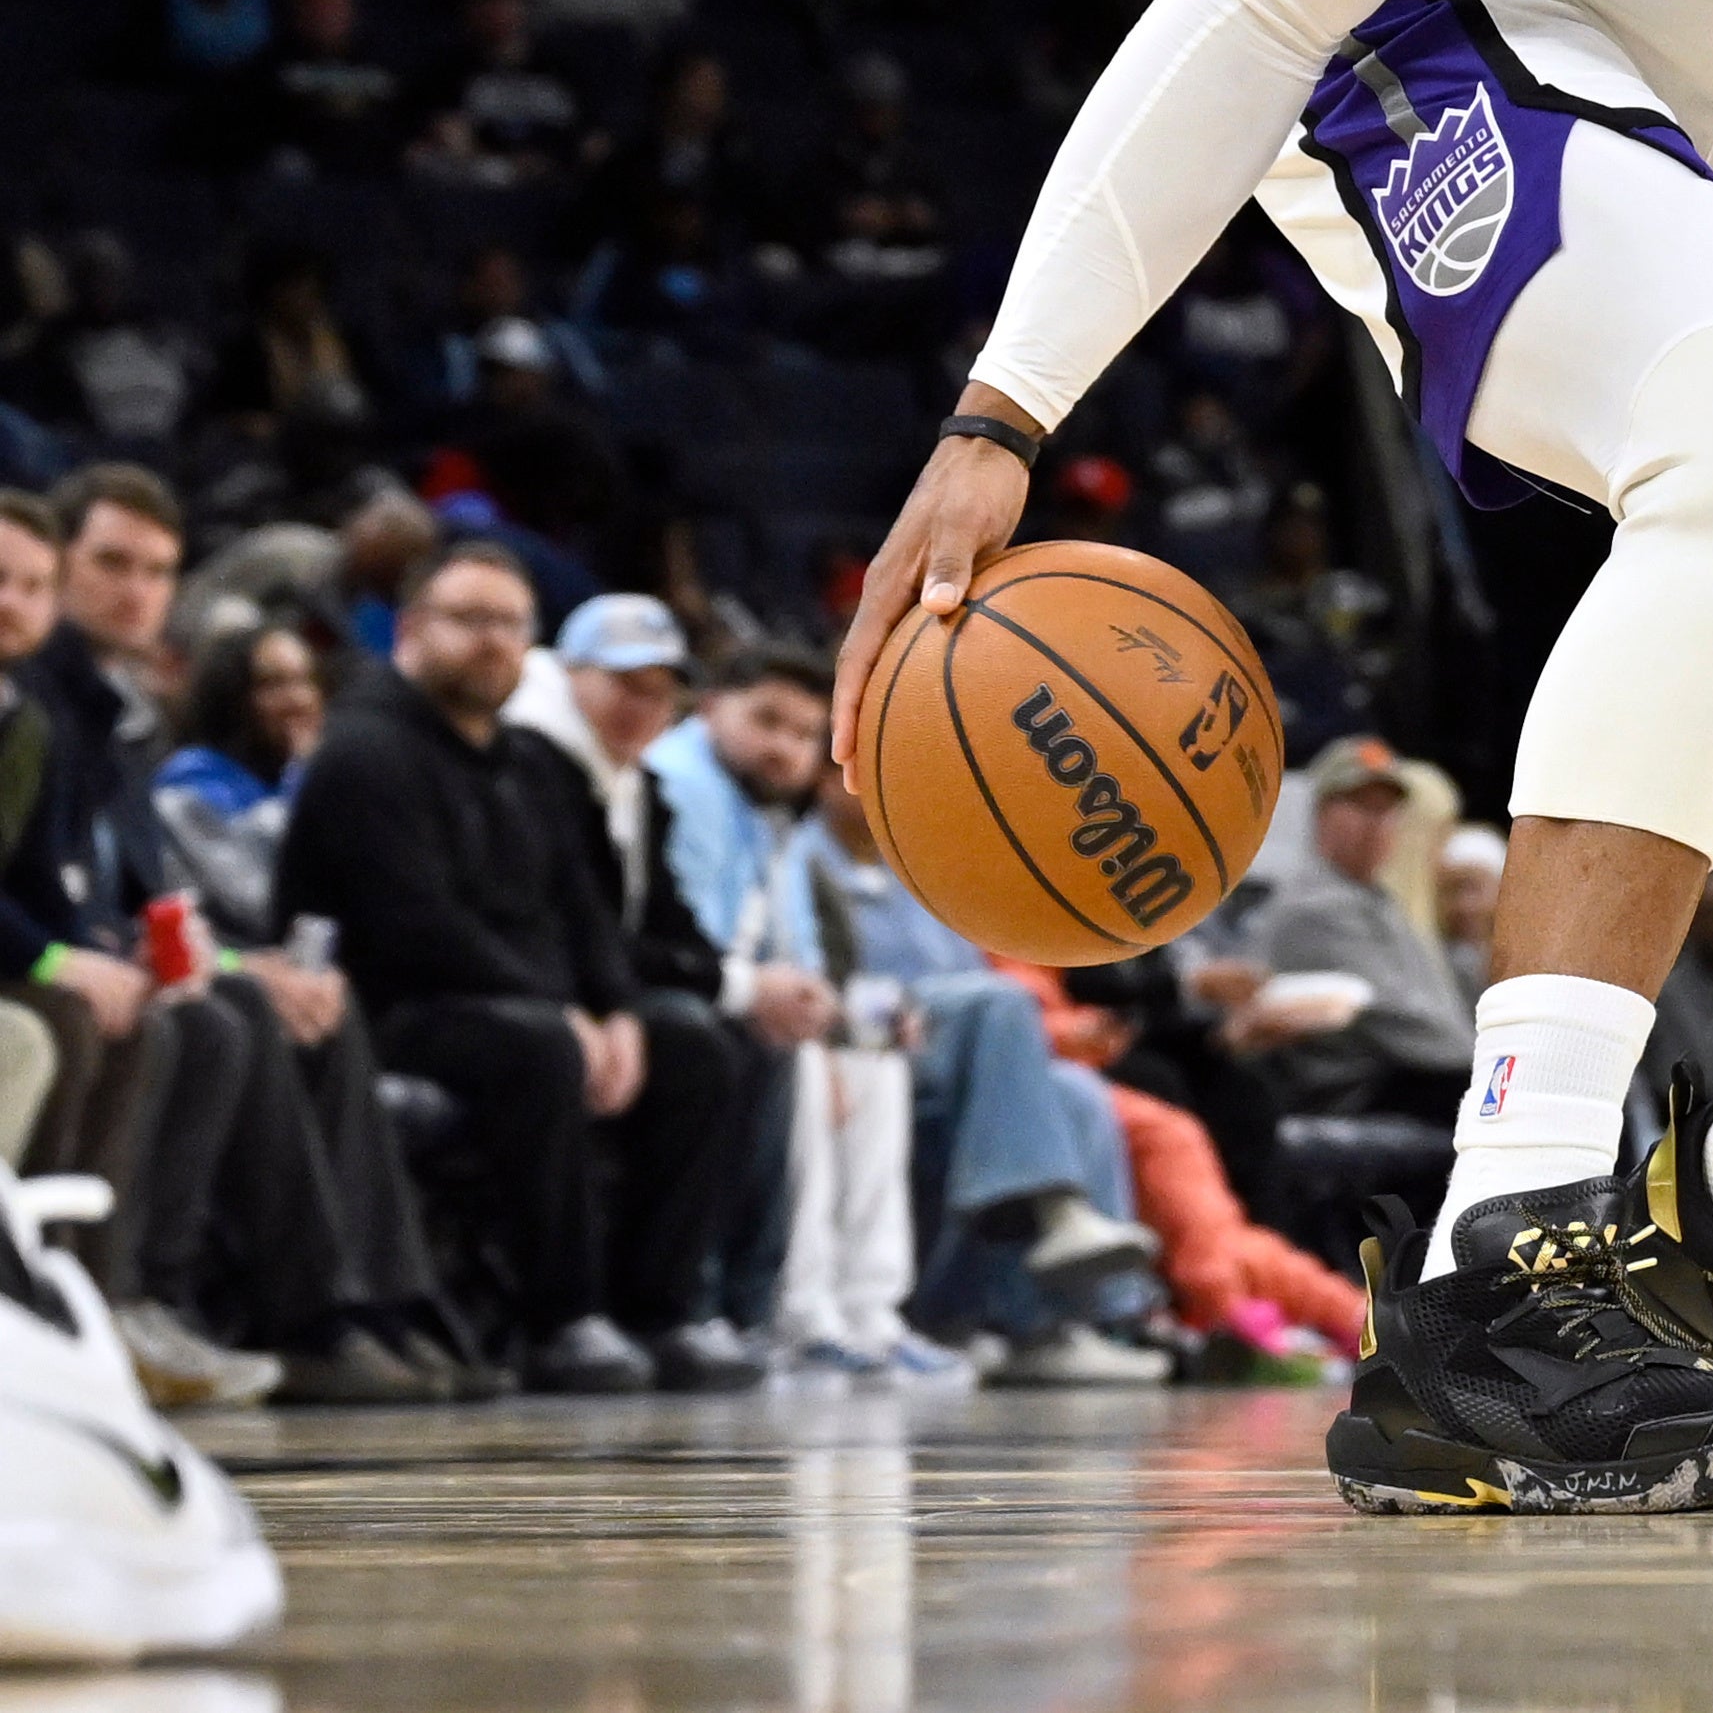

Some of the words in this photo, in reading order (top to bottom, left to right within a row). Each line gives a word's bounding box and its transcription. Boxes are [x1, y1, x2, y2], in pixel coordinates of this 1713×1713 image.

[1390, 126, 1490, 234] SACRAMENTO
[1398, 141, 1507, 269] KINGS
[1010, 682, 1195, 930] Wilson
